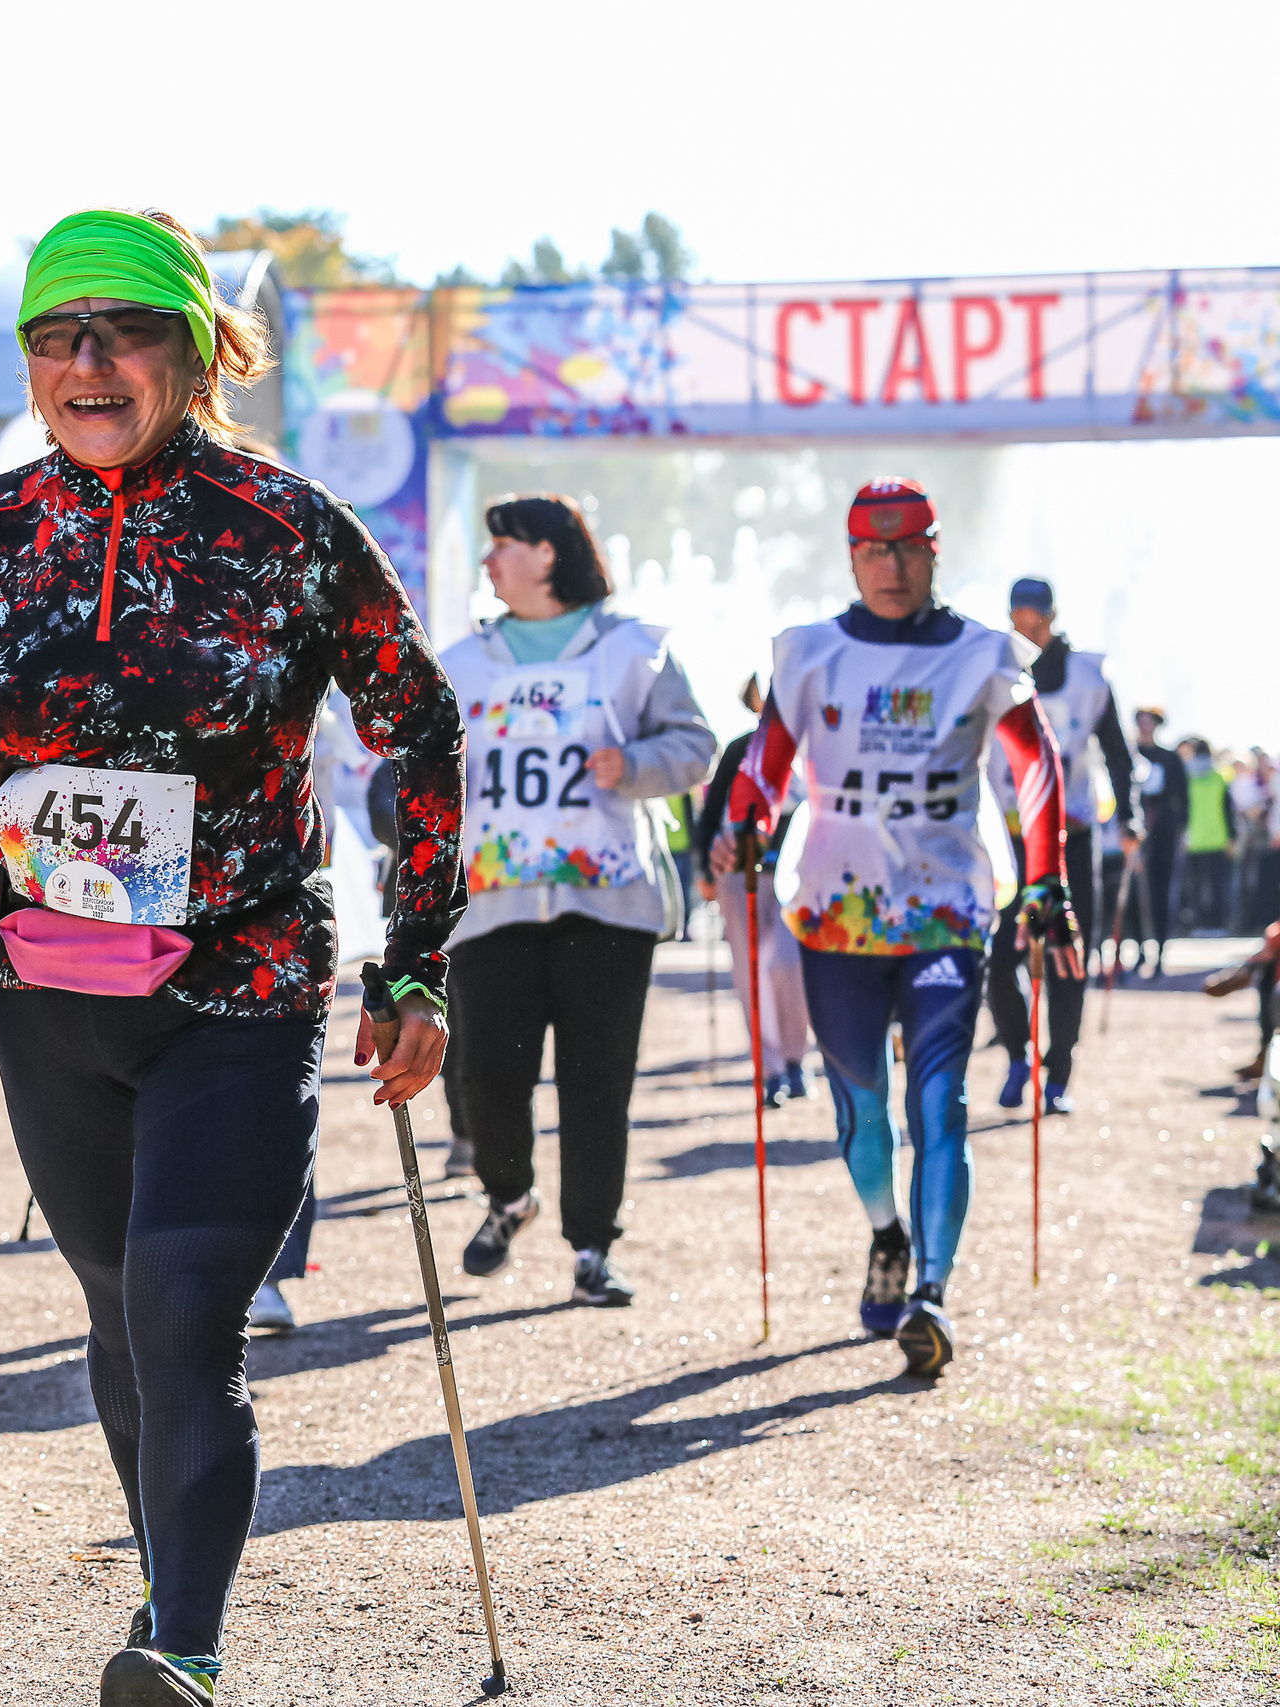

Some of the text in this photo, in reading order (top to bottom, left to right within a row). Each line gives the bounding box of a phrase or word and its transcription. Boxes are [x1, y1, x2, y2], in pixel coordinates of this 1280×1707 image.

[775, 292, 1061, 409] СТАРТ
[510, 680, 565, 708] 462
[480, 744, 591, 810] 462
[32, 789, 146, 855] 454
